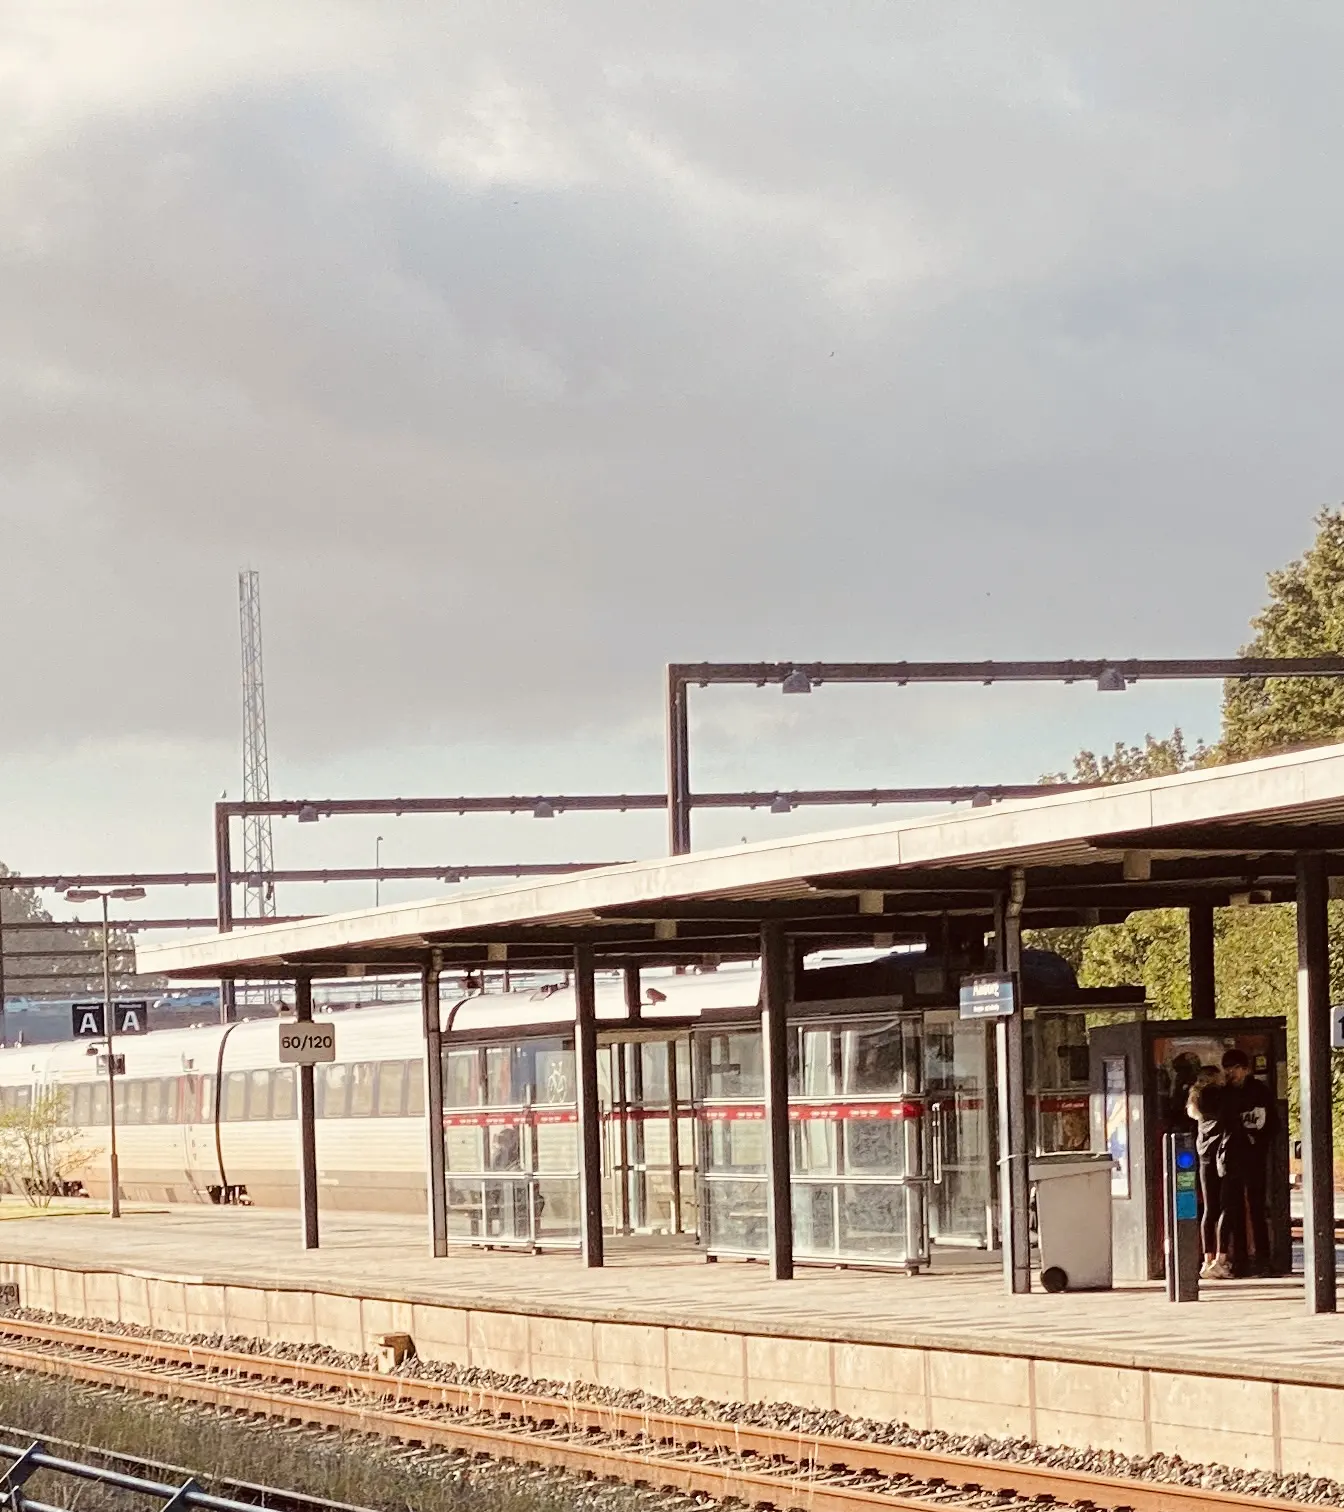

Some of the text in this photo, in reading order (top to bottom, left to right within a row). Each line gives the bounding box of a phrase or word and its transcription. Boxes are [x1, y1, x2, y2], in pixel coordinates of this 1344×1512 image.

[79, 1012, 98, 1034] A
[121, 1010, 140, 1032] A
[282, 1035, 332, 1051] 60/120
